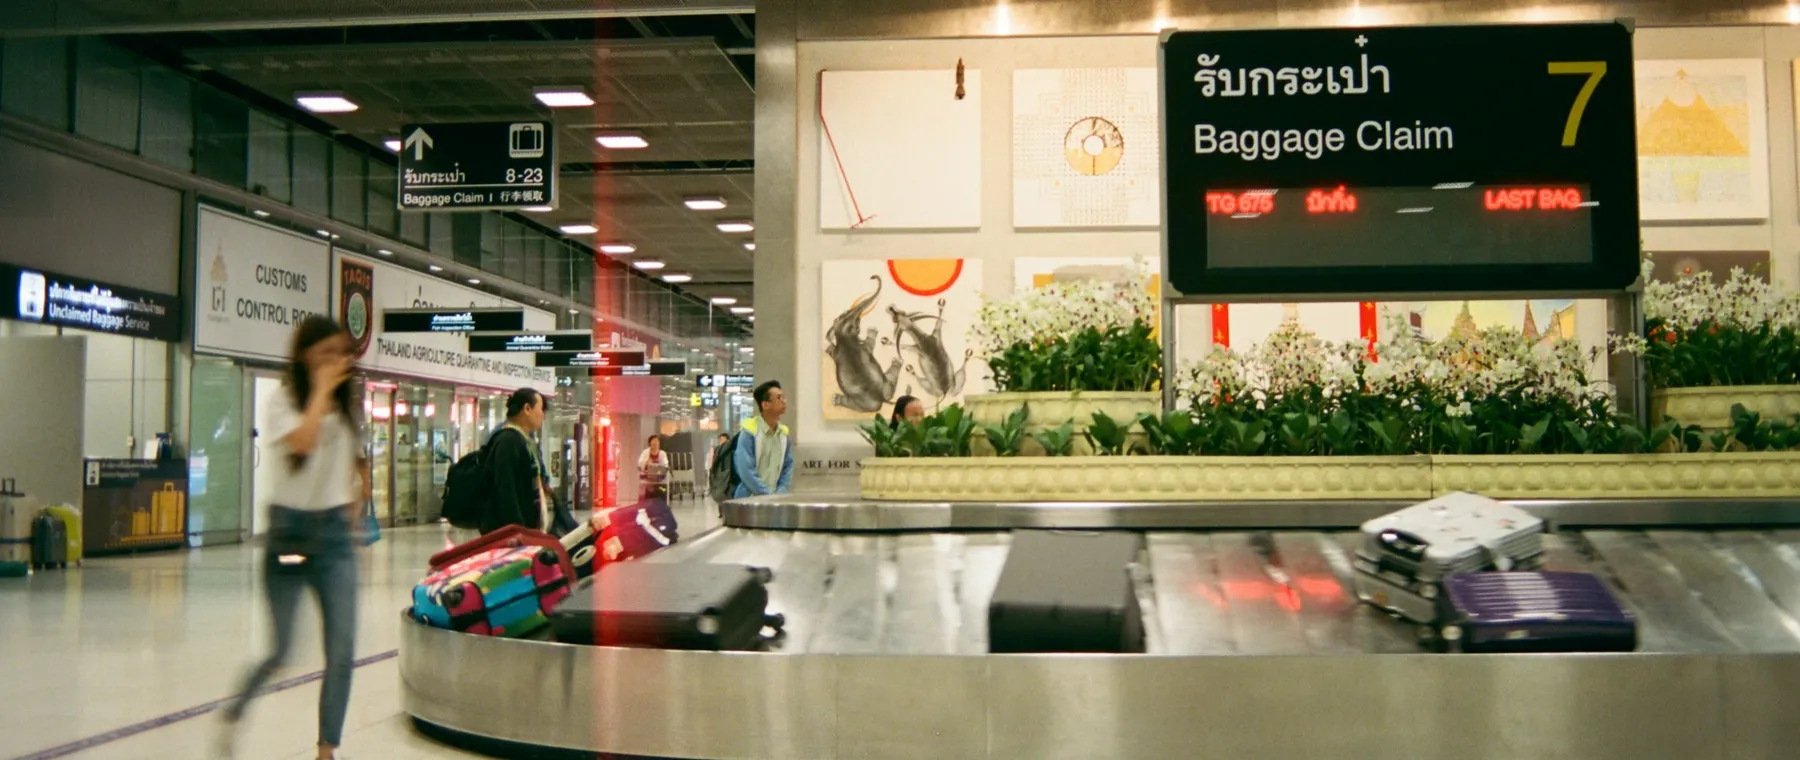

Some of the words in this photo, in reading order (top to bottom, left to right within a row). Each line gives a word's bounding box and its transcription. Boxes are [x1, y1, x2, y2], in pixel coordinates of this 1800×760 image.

[1193, 34, 1391, 97] รับกระเป๋า
[1547, 60, 1608, 147] 7
[1194, 122, 1345, 161] Baggage
[1355, 119, 1454, 152] Claim
[404, 162, 466, 184] รับกระเป๋า
[404, 193, 451, 206] Baggage
[453, 192, 484, 203] Claim
[1206, 191, 1237, 213] TG
[1238, 191, 1275, 213] 675
[1484, 188, 1537, 211] LAST
[1538, 187, 1582, 210] BAG
[256, 264, 307, 293] CUSTOMS
[49, 302, 92, 324] Unclaimed
[92, 308, 124, 329] Baggage
[125, 314, 150, 331] Service
[236, 297, 290, 325] CONTROL
[377, 338, 411, 359] THAILAND
[412, 345, 456, 367] AGRICULTURE
[456, 353, 491, 372] QUARANTINE
[491, 360, 502, 374] AND
[503, 362, 532, 378] INSPECTION
[532, 367, 551, 382] SERVICE
[801, 460, 823, 469] ART
[828, 460, 850, 469] FOR
